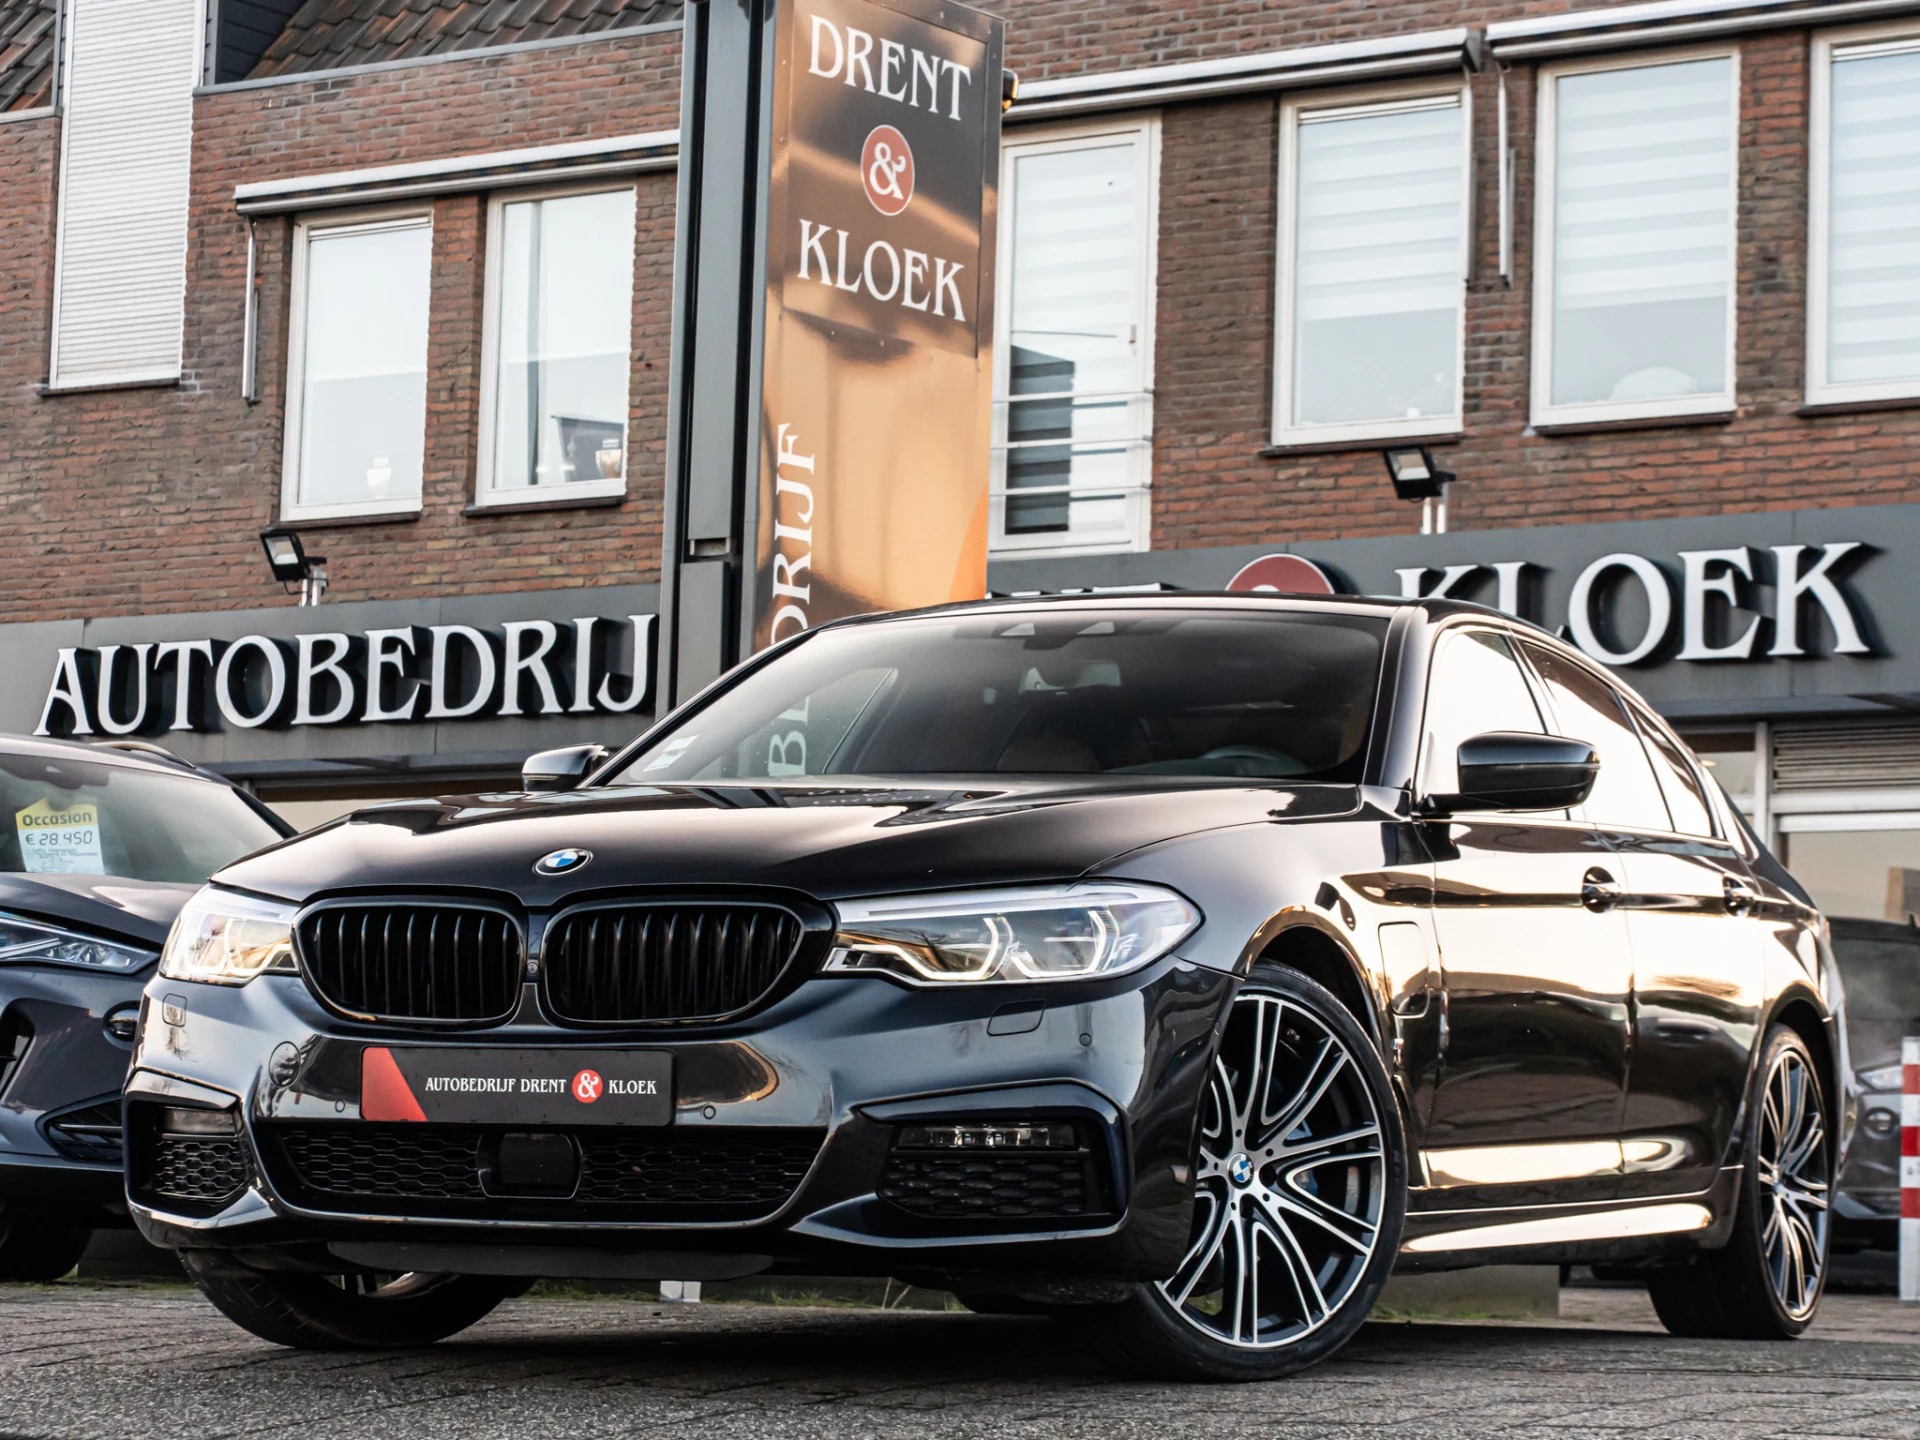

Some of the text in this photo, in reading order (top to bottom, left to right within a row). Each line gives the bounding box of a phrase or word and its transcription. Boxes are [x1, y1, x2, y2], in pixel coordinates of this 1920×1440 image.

[808, 14, 972, 121] DRENT
[869, 142, 907, 200] &
[797, 219, 966, 322] KLOEK
[22, 812, 92, 826] Occasion
[39, 831, 93, 846] 28.450
[425, 1073, 657, 1098] AUTOBEDRIJF DRENT & KLOEK
